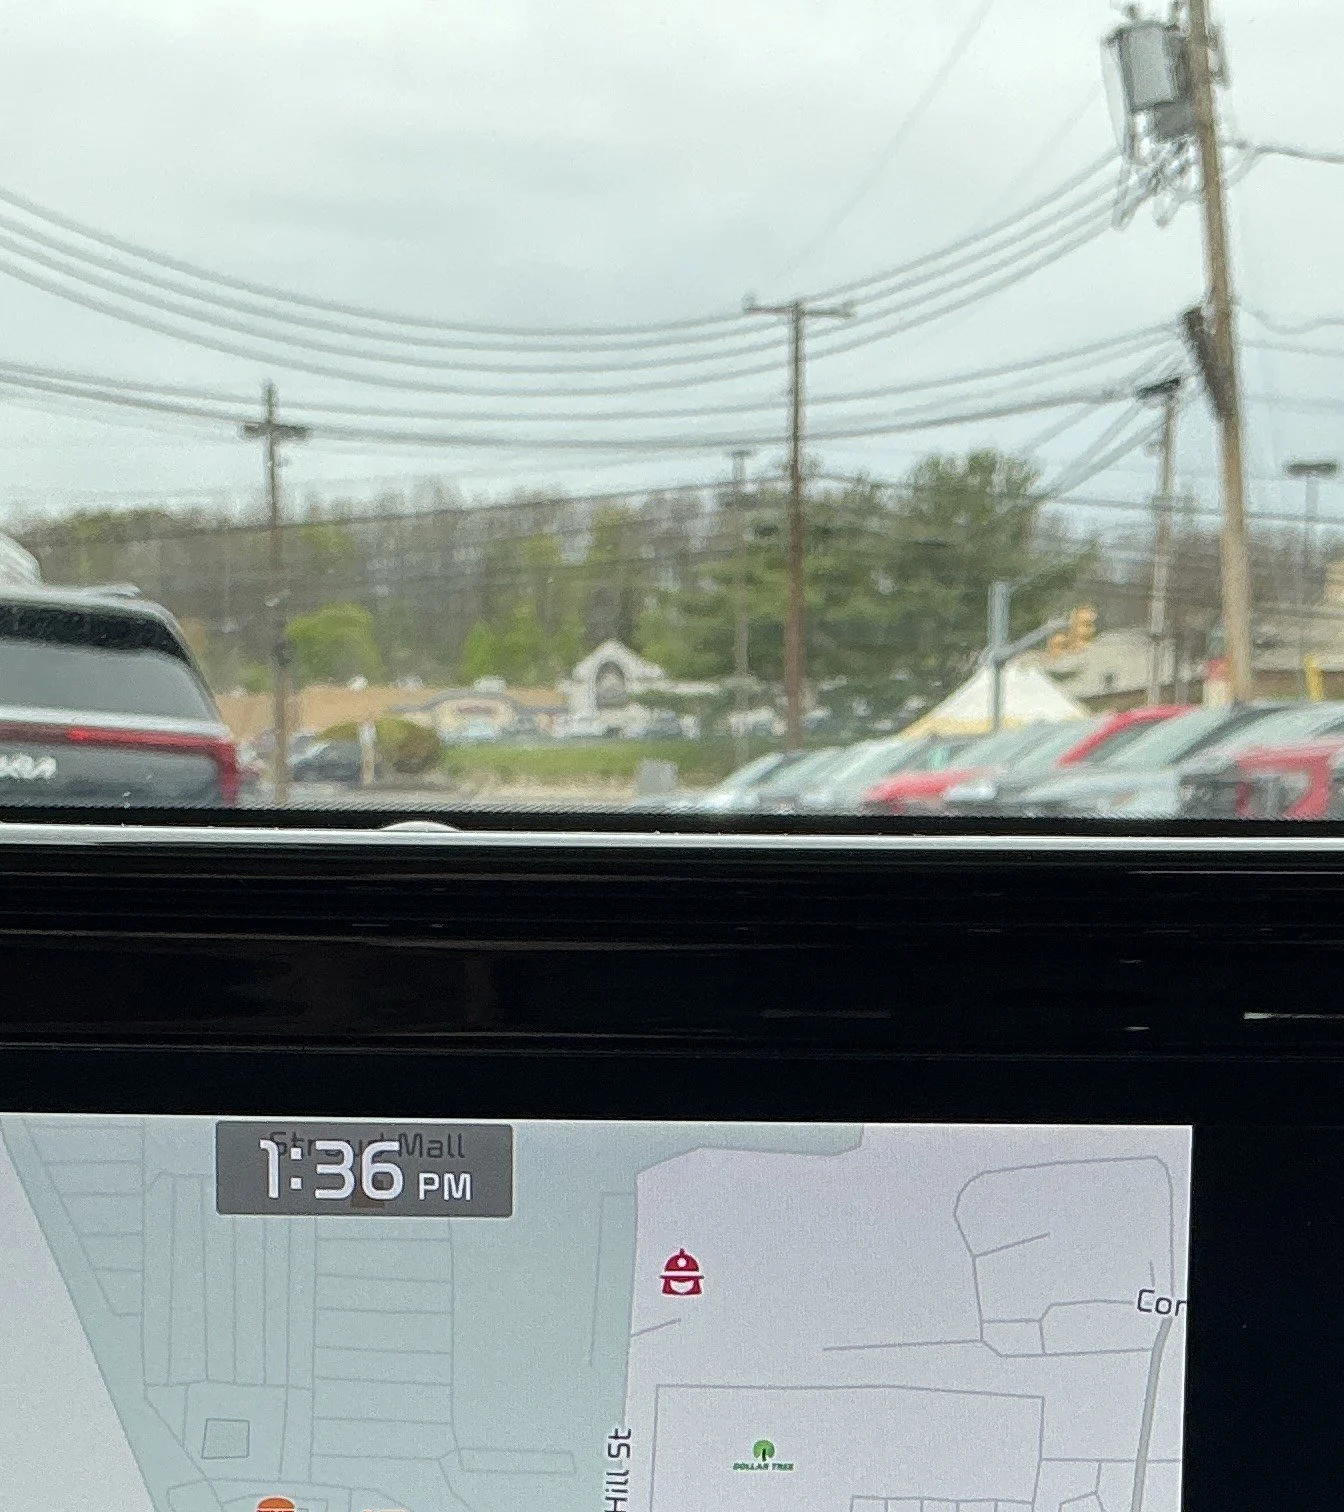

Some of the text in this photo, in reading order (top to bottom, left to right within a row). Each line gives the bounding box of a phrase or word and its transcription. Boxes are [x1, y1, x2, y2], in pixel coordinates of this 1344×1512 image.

[398, 1132, 466, 1159] Mall
[259, 1138, 472, 1201] 1:36 PM
[607, 1428, 632, 1459] St
